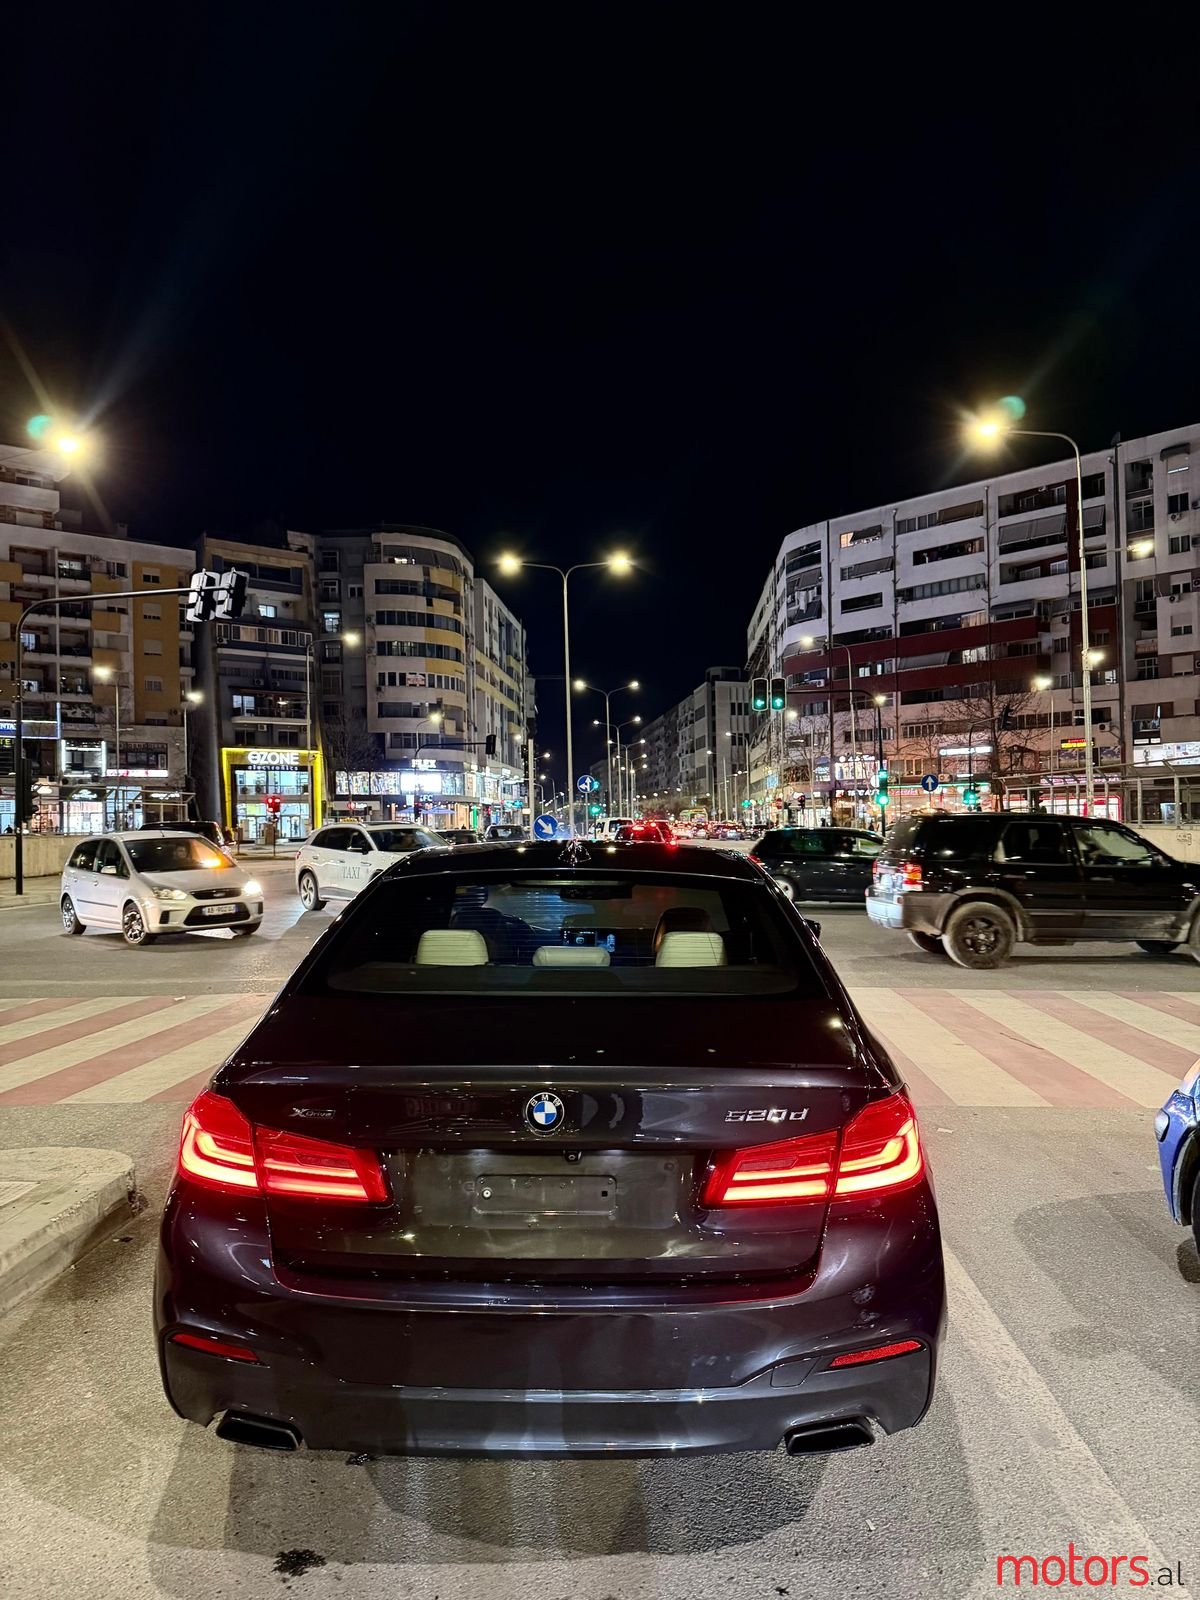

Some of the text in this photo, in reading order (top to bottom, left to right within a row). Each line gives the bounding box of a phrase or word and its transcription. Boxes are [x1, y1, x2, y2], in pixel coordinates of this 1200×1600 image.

[342, 866, 361, 880] TAXI
[530, 1094, 561, 1107] BMW
[724, 1107, 810, 1123] 520d
